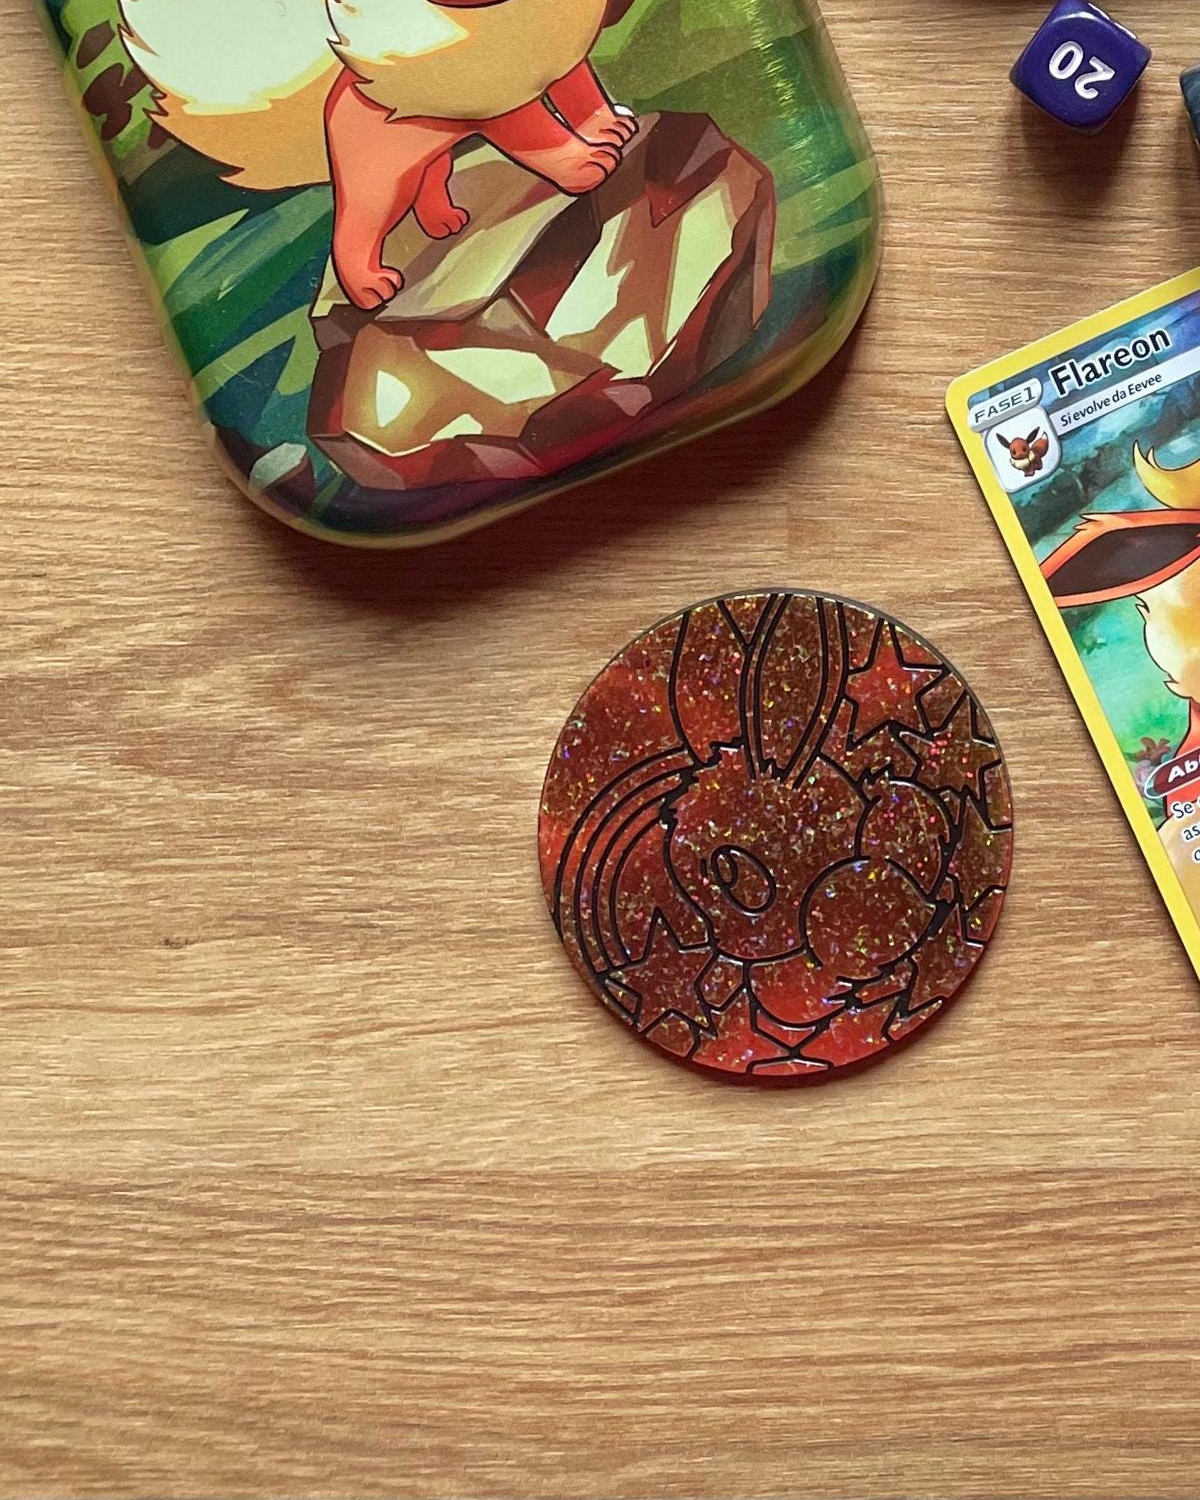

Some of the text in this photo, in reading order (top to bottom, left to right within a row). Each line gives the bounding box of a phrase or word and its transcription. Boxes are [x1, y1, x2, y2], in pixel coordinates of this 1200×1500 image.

[1048, 41, 1115, 100] 20
[1050, 329, 1170, 395] Flareon
[1074, 373, 1162, 421] evolve da Eevee
[1173, 800, 1194, 818] Se
